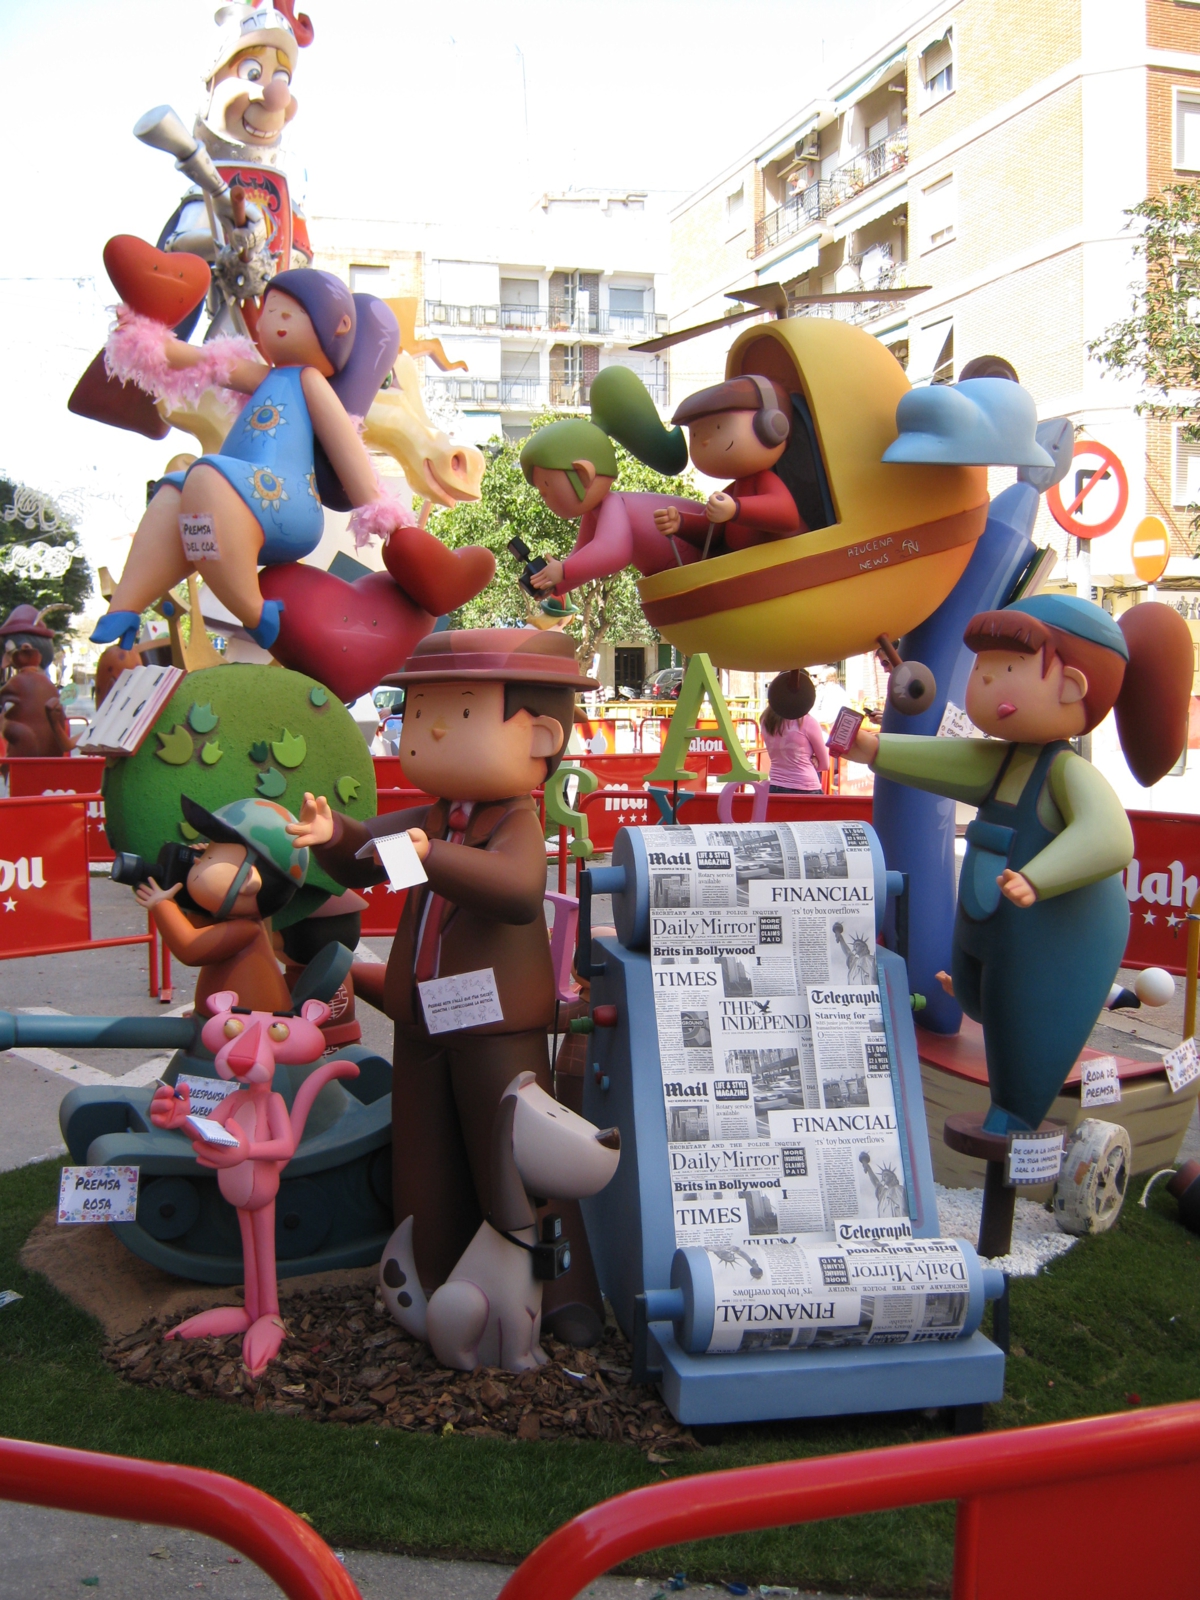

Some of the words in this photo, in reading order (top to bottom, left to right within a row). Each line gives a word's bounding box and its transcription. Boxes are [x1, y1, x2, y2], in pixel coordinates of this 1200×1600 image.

[184, 524, 211, 535] PREMSA
[186, 542, 200, 552] DEL
[201, 542, 216, 552] COR
[847, 537, 894, 557] AZUCENA
[859, 553, 889, 570] NEWS
[643, 653, 768, 782] A
[836, 719, 852, 741] TINTA
[648, 852, 691, 865] Mail
[772, 886, 874, 901] FINANCIAL
[803, 908, 814, 916] toy
[652, 918, 699, 938] Daily
[701, 918, 756, 934] Mirror
[654, 946, 680, 956] Brits
[682, 946, 694, 956] in
[696, 946, 756, 958] Bollywood
[655, 971, 717, 986] TIMES
[811, 990, 881, 1006] Telegraph
[719, 1001, 755, 1015] THE
[721, 1014, 812, 1030] INDEPEND
[815, 1012, 851, 1020] Starving
[1086, 1070, 1104, 1082] RODA
[1106, 1069, 1114, 1078] DE
[664, 1082, 708, 1097] Mail
[1086, 1086, 1114, 1098] PREMSA
[792, 1115, 896, 1132] FINANCIAL
[826, 1138, 837, 1146] toy
[852, 1136, 884, 1144] overflows
[672, 1152, 720, 1172] Daily
[723, 1150, 780, 1168] Mirror
[75, 1177, 121, 1190] PREMSA
[674, 1181, 703, 1192] Brits
[705, 1180, 717, 1190] in
[718, 1178, 781, 1192] Bollywood
[83, 1198, 112, 1210] ROSA
[676, 1207, 742, 1226] TIMES
[840, 1223, 912, 1240] Telegraph
[846, 1245, 913, 1256] Bollywood
[852, 1264, 914, 1282] Mirror
[914, 1260, 966, 1280] Daily
[732, 1288, 770, 1298] overflows
[772, 1288, 786, 1297] box
[788, 1286, 800, 1296] toy
[716, 1302, 836, 1322] FINANCIAL
